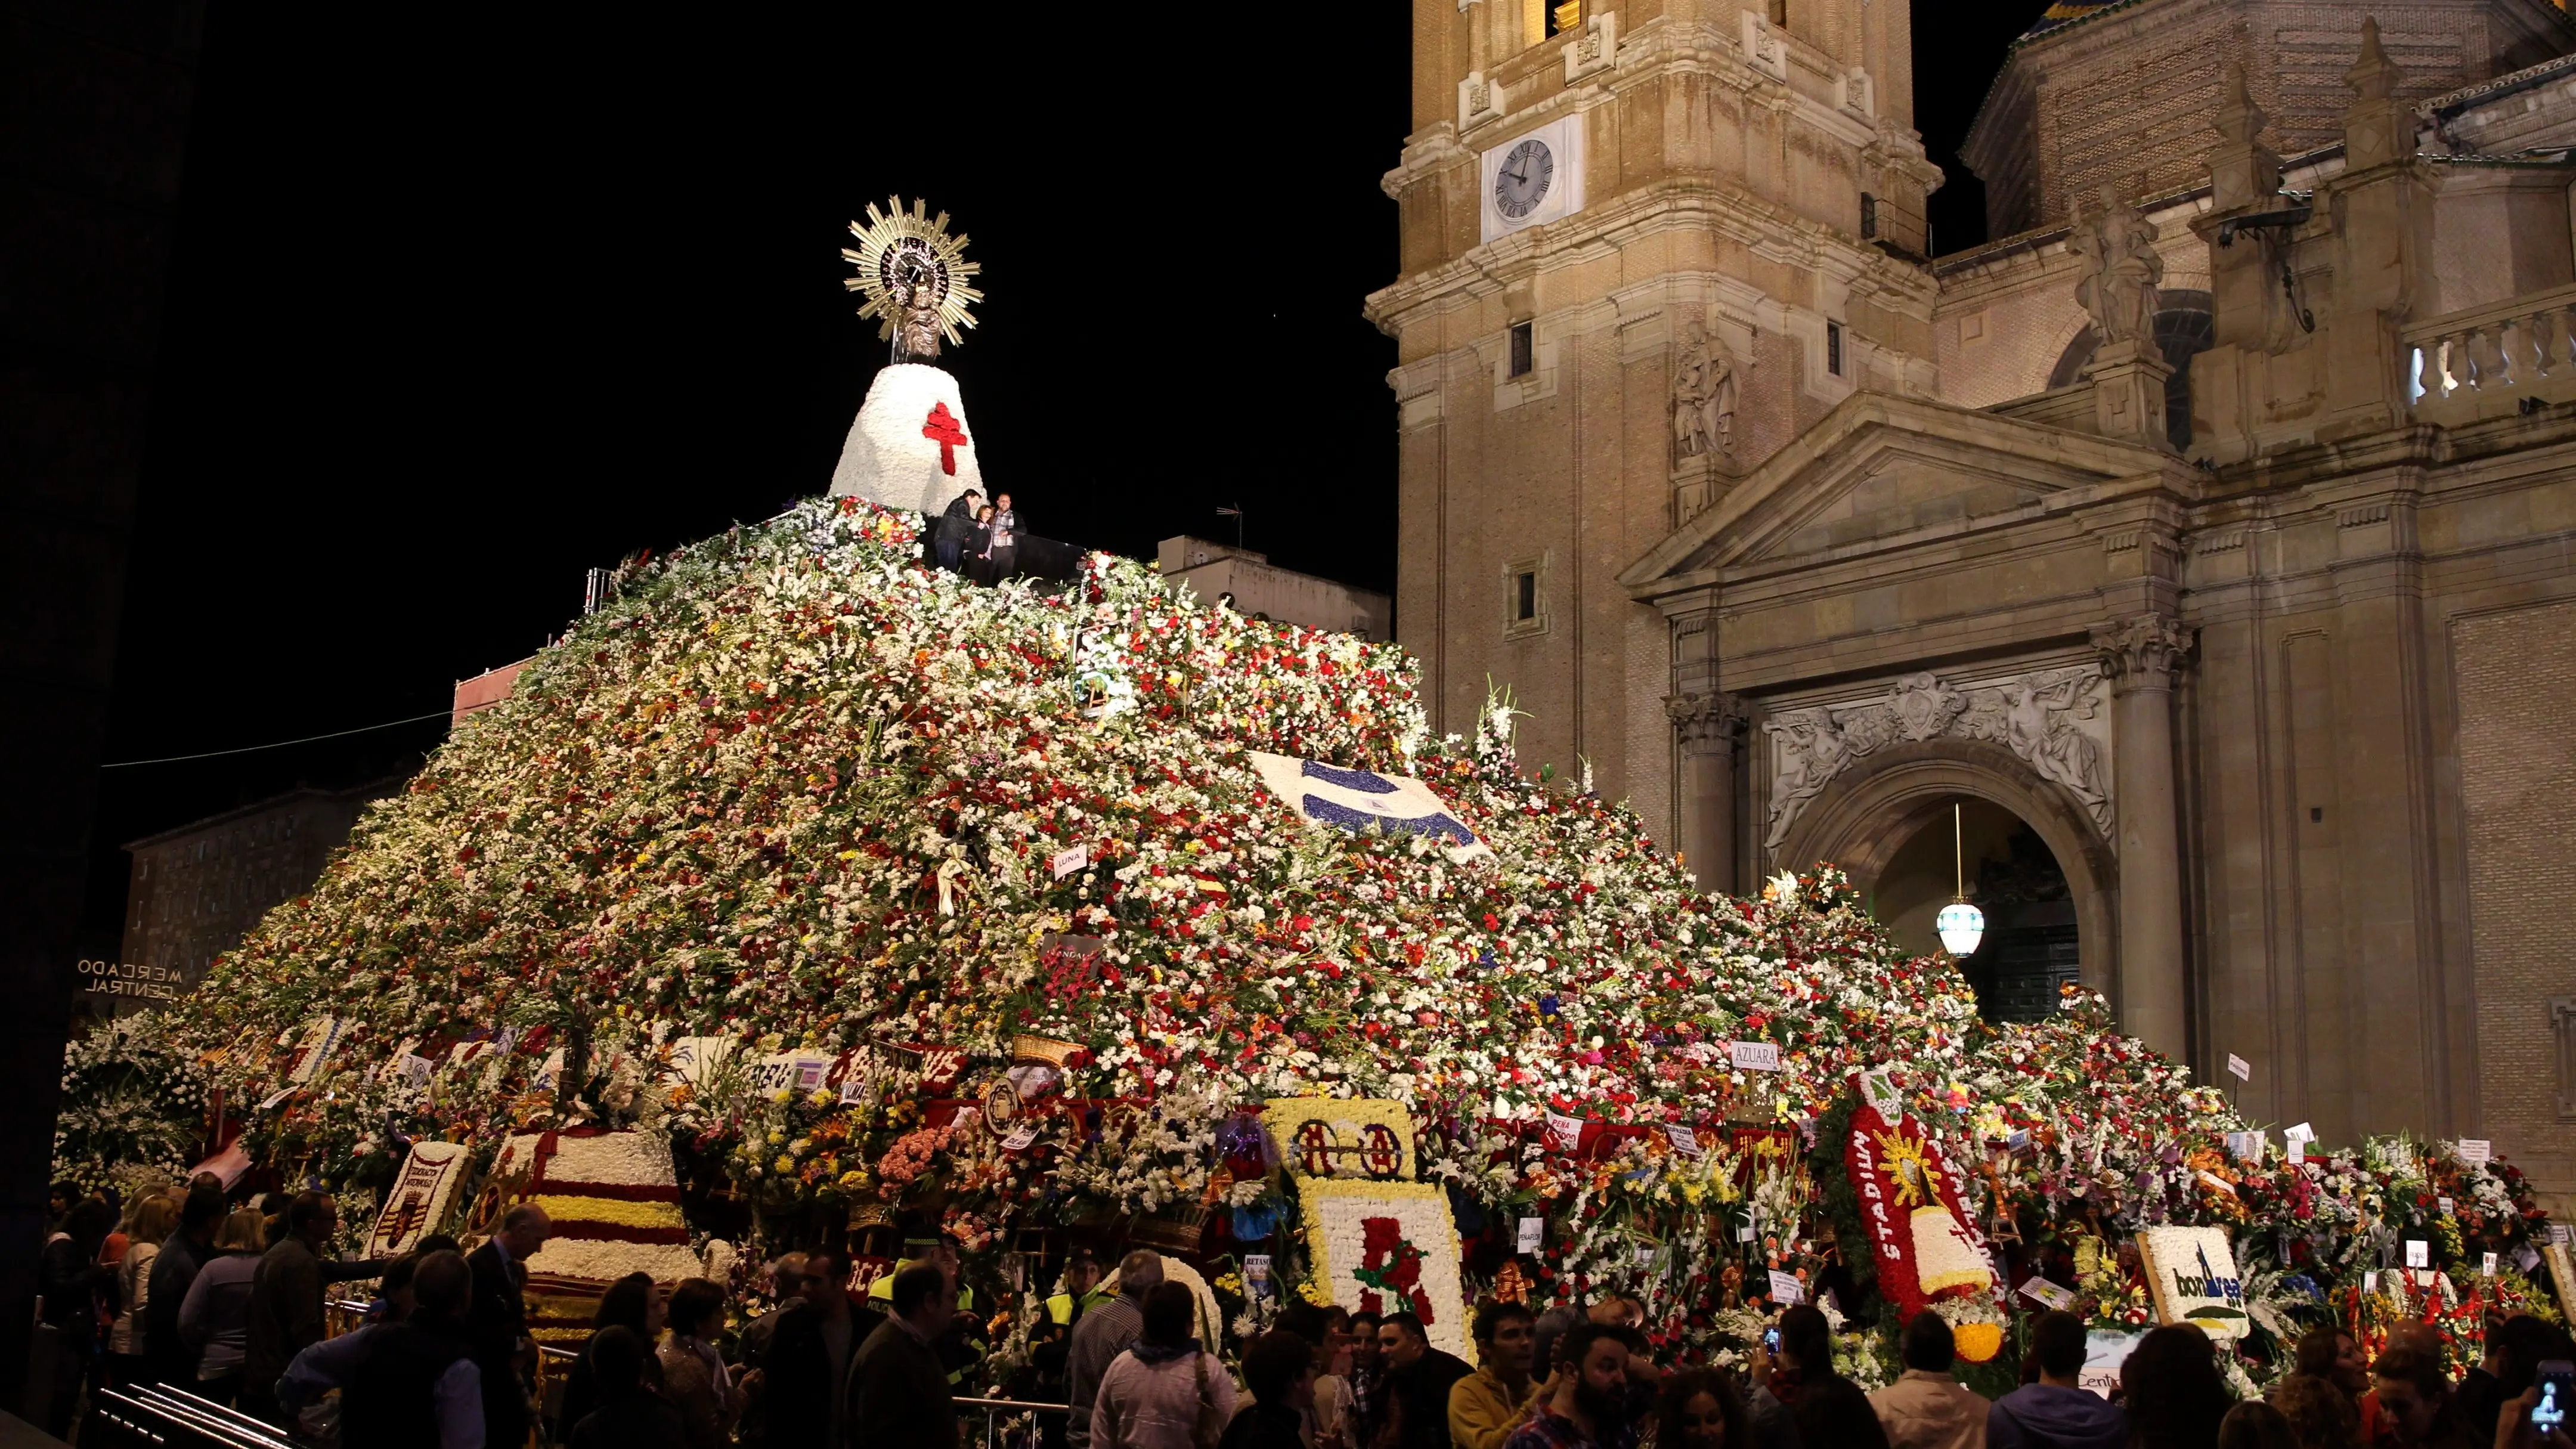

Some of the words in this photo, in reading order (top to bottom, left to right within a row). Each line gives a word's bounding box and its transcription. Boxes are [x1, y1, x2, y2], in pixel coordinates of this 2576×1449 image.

[1058, 853, 1080, 867] LUNA
[1735, 1046, 1776, 1065] AZUARA
[1552, 1118, 1570, 1129] PEÑA
[1853, 1130, 1901, 1260] STADIUM
[1519, 1232, 1541, 1241] PEÑAFLOR
